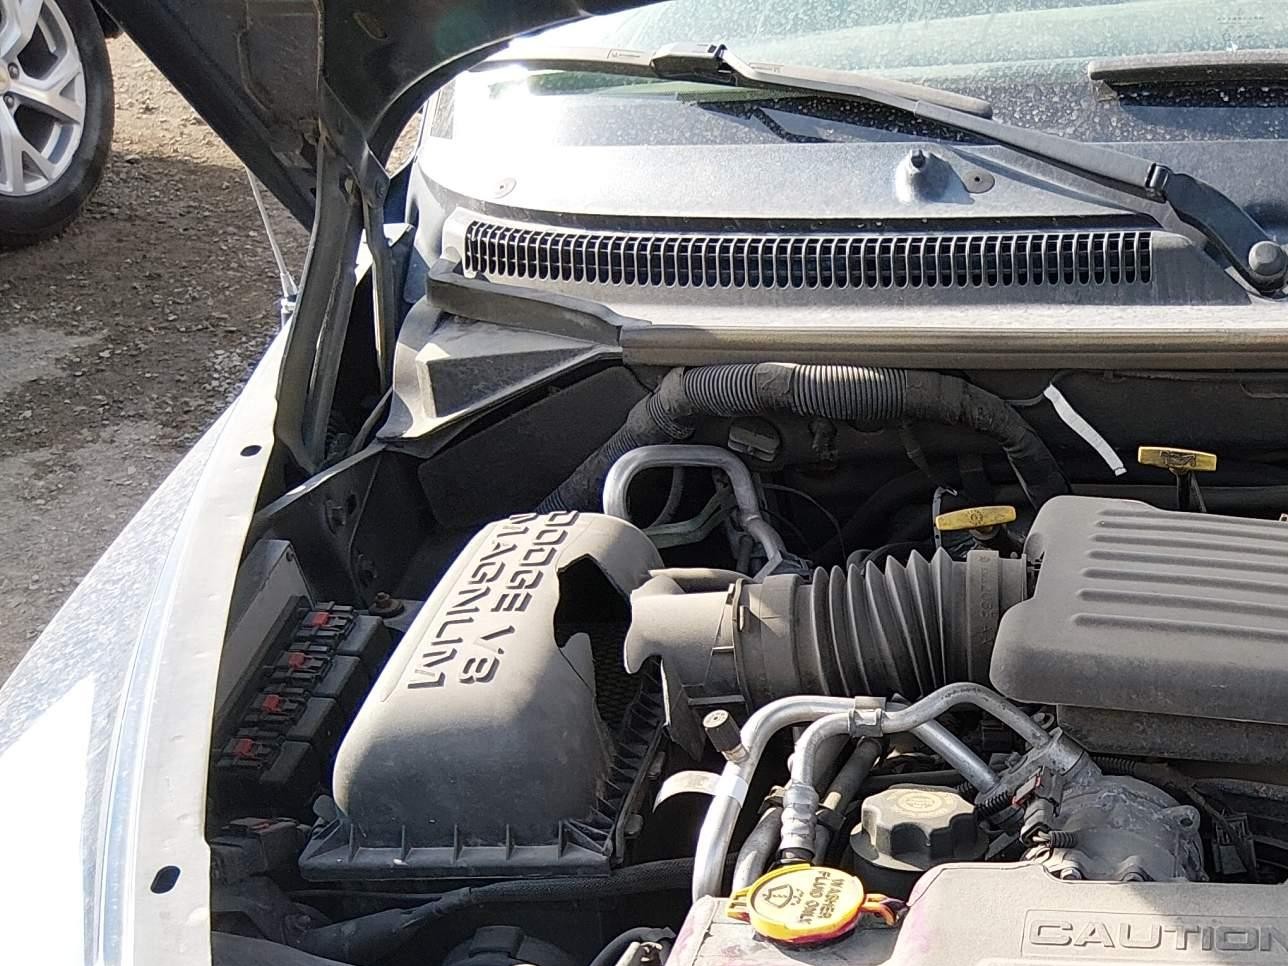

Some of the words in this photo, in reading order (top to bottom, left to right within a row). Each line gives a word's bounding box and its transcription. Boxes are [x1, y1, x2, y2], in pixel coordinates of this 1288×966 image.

[489, 510, 579, 613] DODGE
[407, 512, 540, 690] MAGNUM
[459, 625, 515, 684] V8
[810, 870, 831, 898] FLUID
[818, 878, 845, 919] WASHER
[799, 900, 820, 924] ONLY
